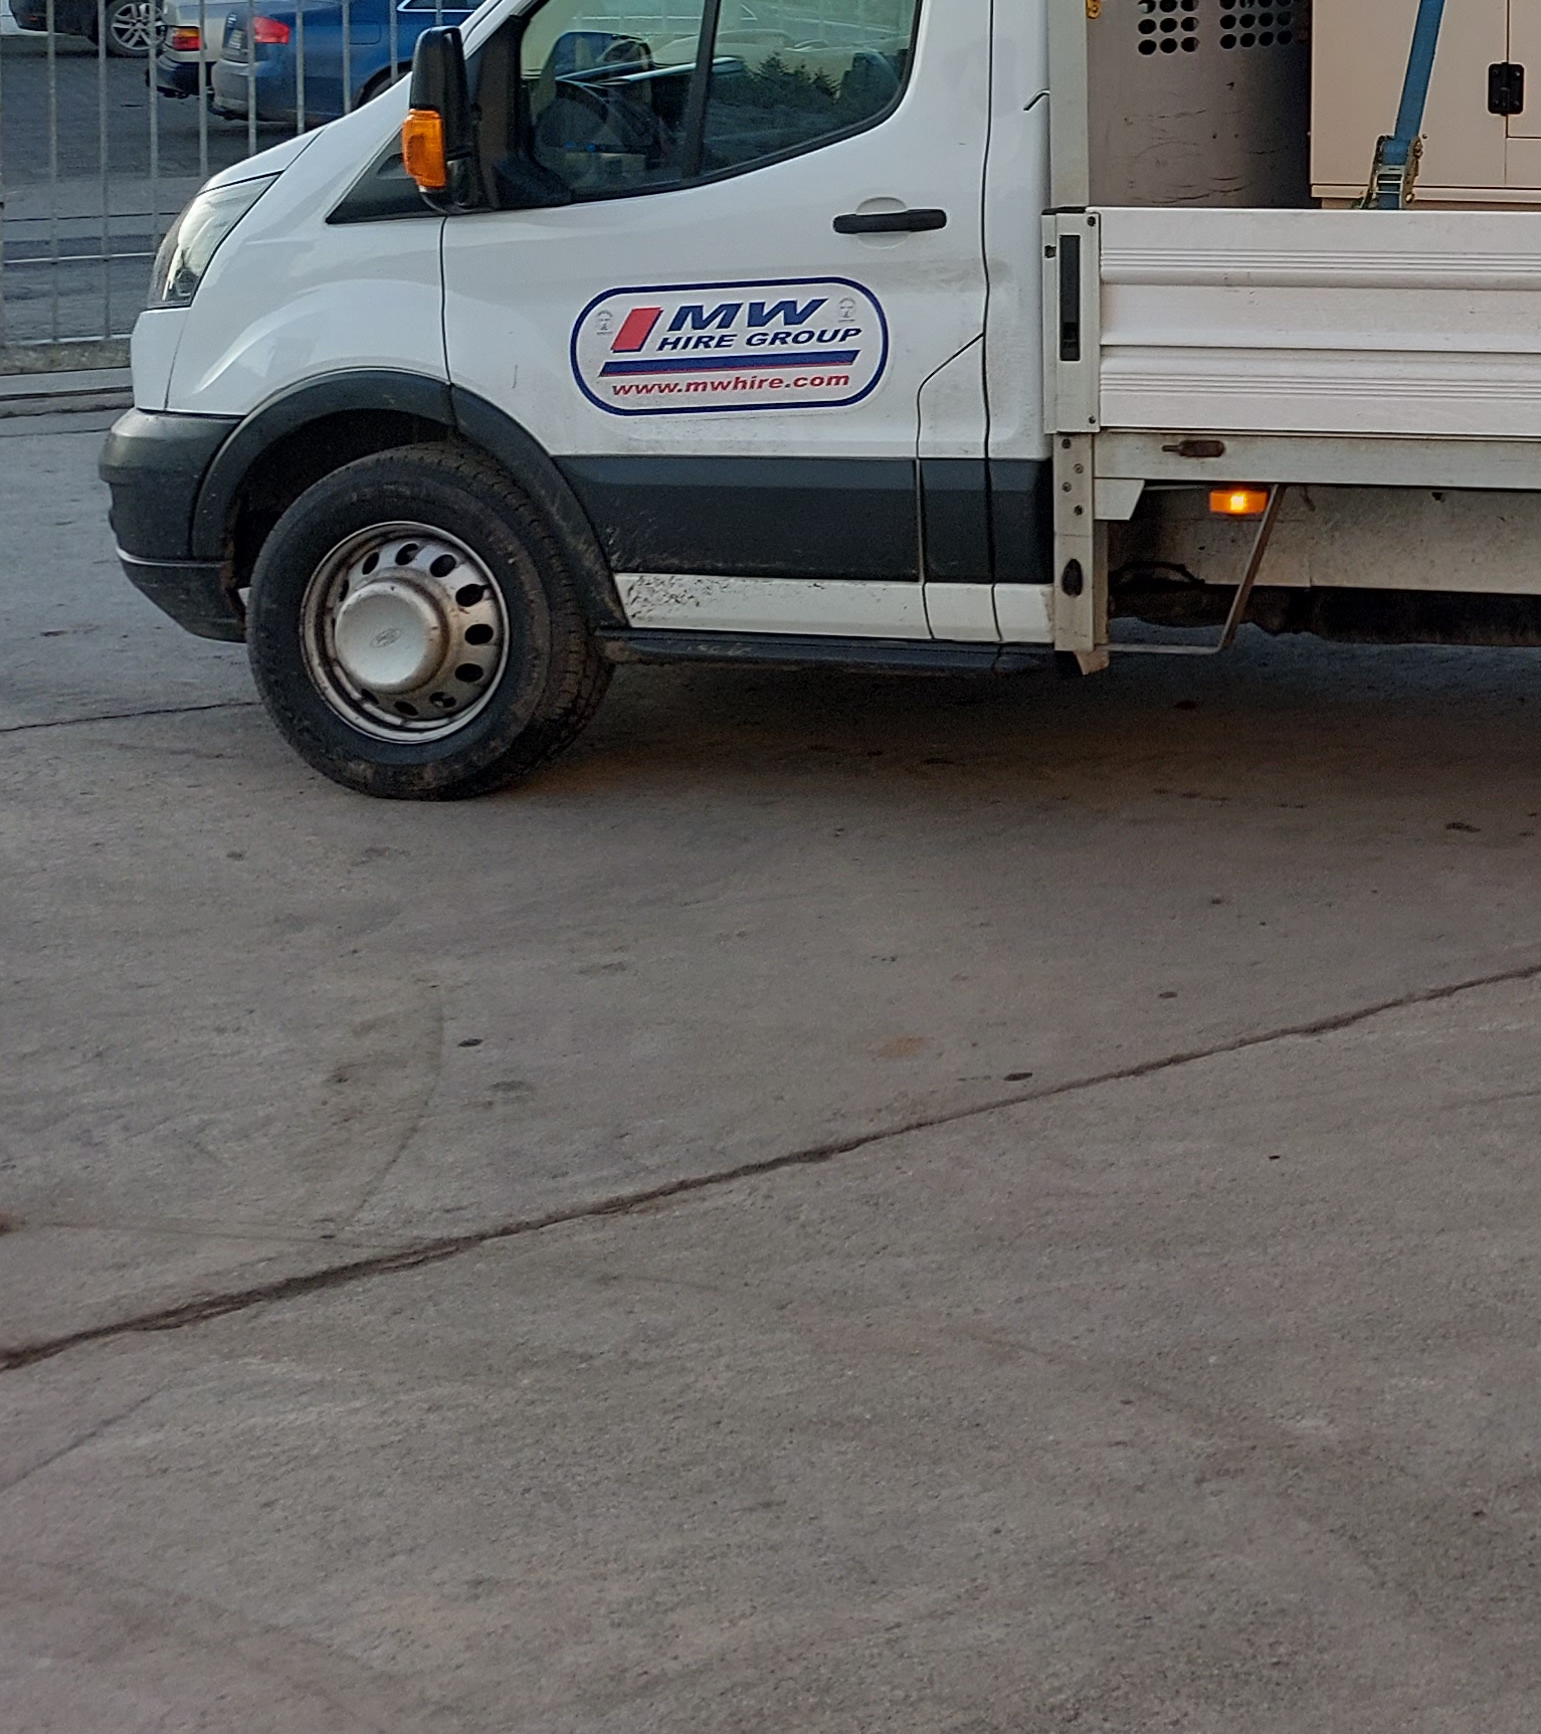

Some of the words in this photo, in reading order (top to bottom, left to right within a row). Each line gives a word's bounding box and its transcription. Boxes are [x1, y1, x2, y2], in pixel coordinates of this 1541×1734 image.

[667, 297, 829, 332] MW
[656, 333, 738, 352] HIRE
[744, 327, 862, 347] GROUP
[612, 374, 850, 396] www.mwhire.com
